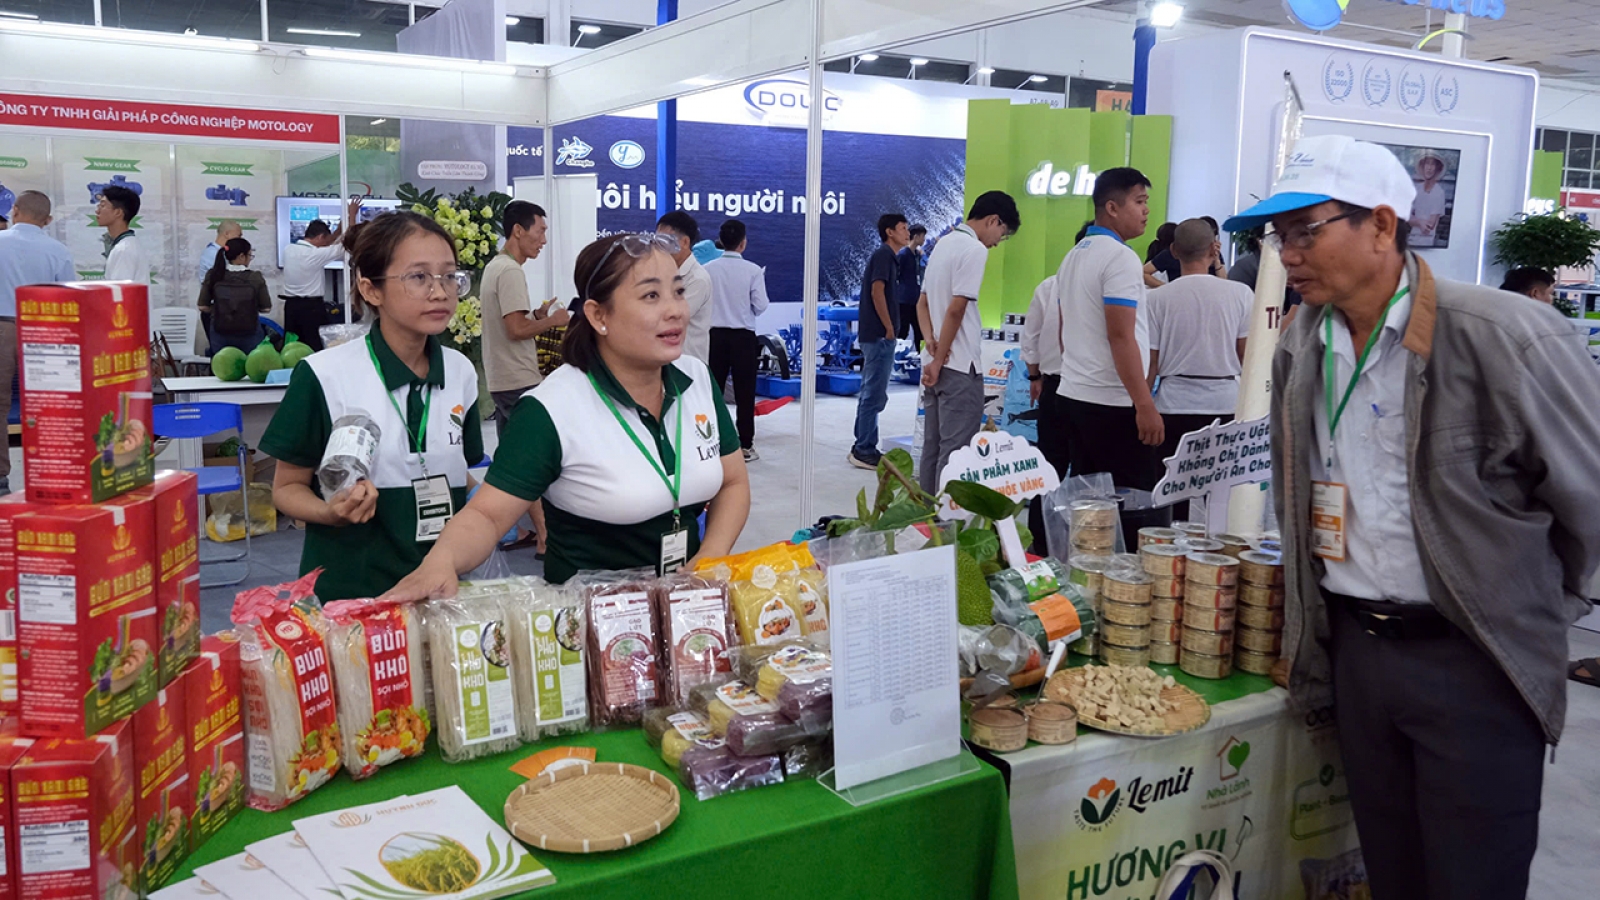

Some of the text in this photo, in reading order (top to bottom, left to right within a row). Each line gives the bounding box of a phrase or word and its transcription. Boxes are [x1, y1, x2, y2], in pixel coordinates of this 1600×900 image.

[30, 105, 48, 116] TY
[52, 107, 90, 119] TNHH
[92, 107, 119, 121] GIẢI
[161, 111, 198, 126] CÔNG
[200, 115, 246, 131] NGHIỆP
[248, 119, 313, 133] MOTOLOGY
[1028, 161, 1070, 195] de
[708, 188, 784, 216] người
[1215, 429, 1246, 446] Thực
[983, 458, 1010, 481] PHẨM
[1013, 457, 1039, 473] XANH
[1177, 452, 1215, 474] Không
[1241, 440, 1270, 458] Dành
[1020, 476, 1044, 493] VÀNG
[1162, 479, 1186, 496] Cho
[1189, 466, 1228, 489] Người
[371, 626, 405, 654] BÚN
[295, 646, 325, 676] BÚN
[374, 655, 408, 681] KHÔ
[300, 672, 329, 703] KHÔ
[1127, 766, 1194, 814] Lemit
